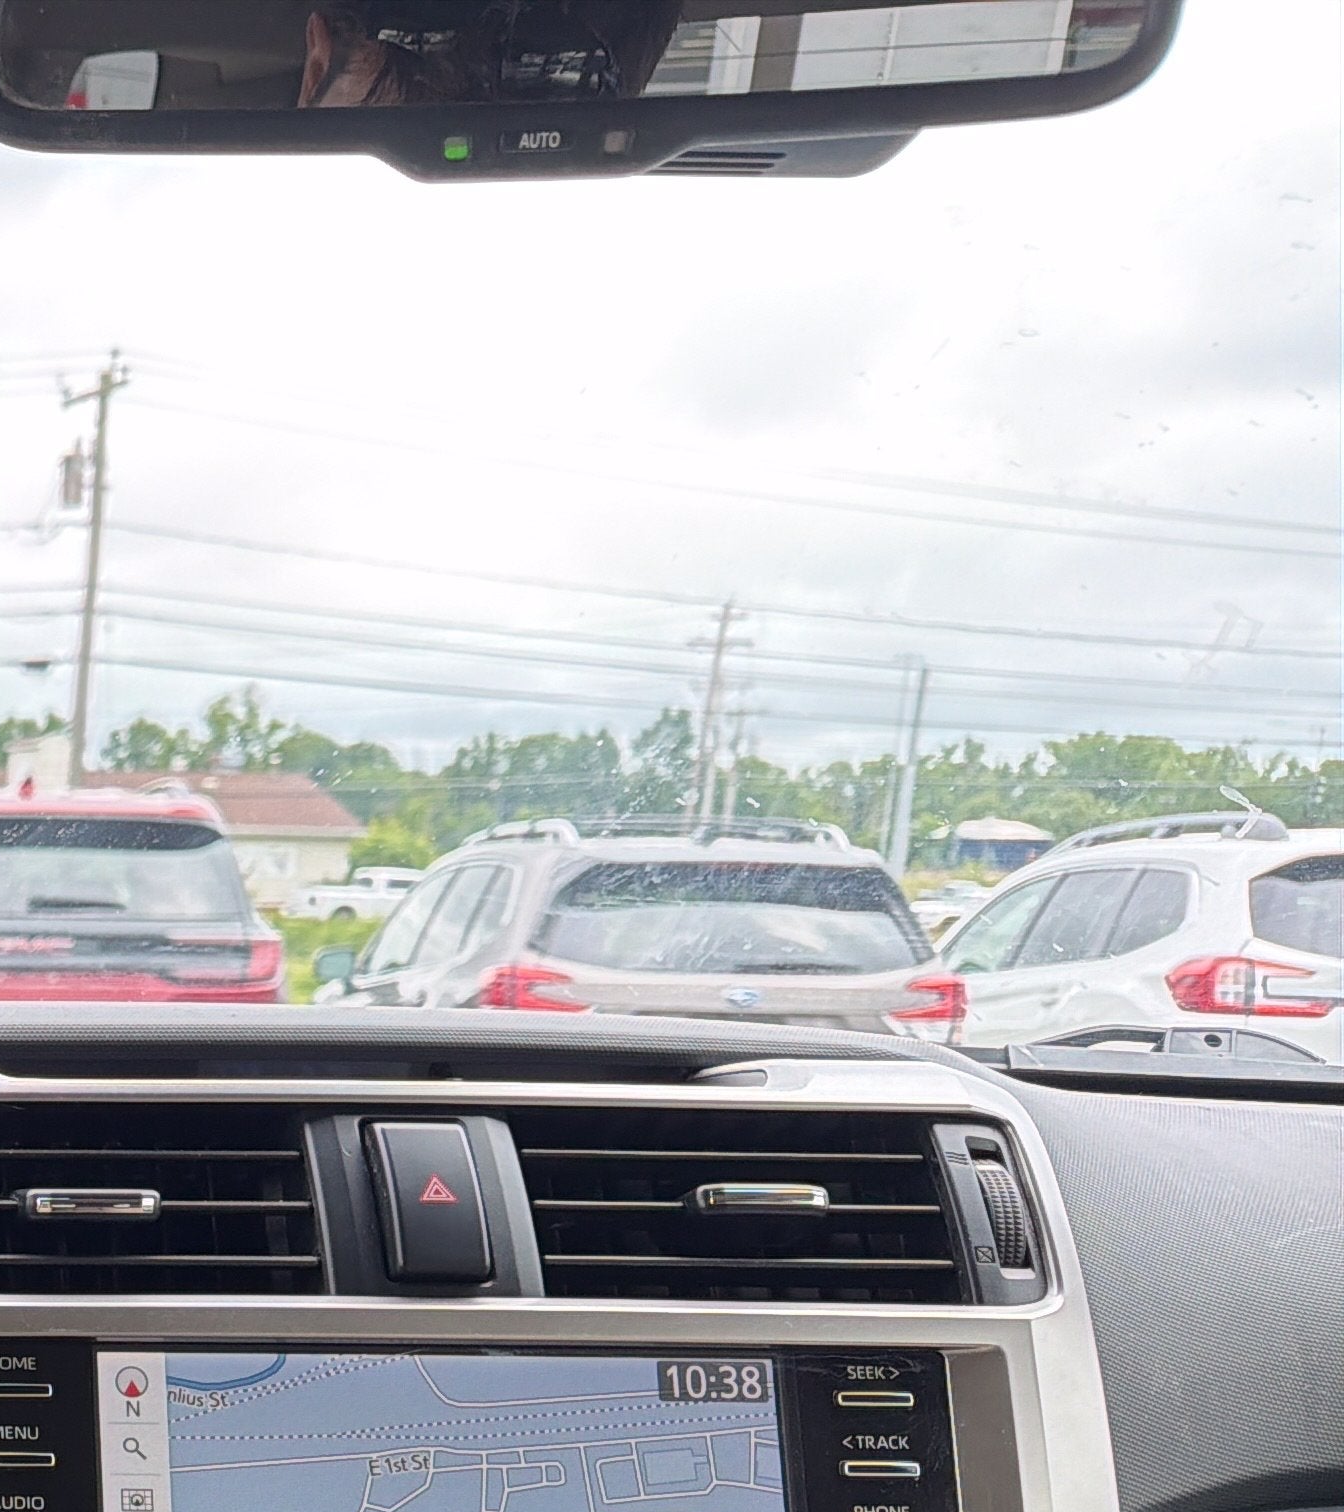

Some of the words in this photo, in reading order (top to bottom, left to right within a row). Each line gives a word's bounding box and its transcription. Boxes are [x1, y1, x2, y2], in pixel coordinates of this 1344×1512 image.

[518, 131, 561, 149] AUTO
[666, 1365, 763, 1399] 10:38
[167, 1387, 204, 1408] nlius
[208, 1391, 228, 1408] St
[125, 1401, 141, 1417] N
[369, 1459, 380, 1477] E
[384, 1458, 408, 1474] 1st
[412, 1454, 430, 1471] St
